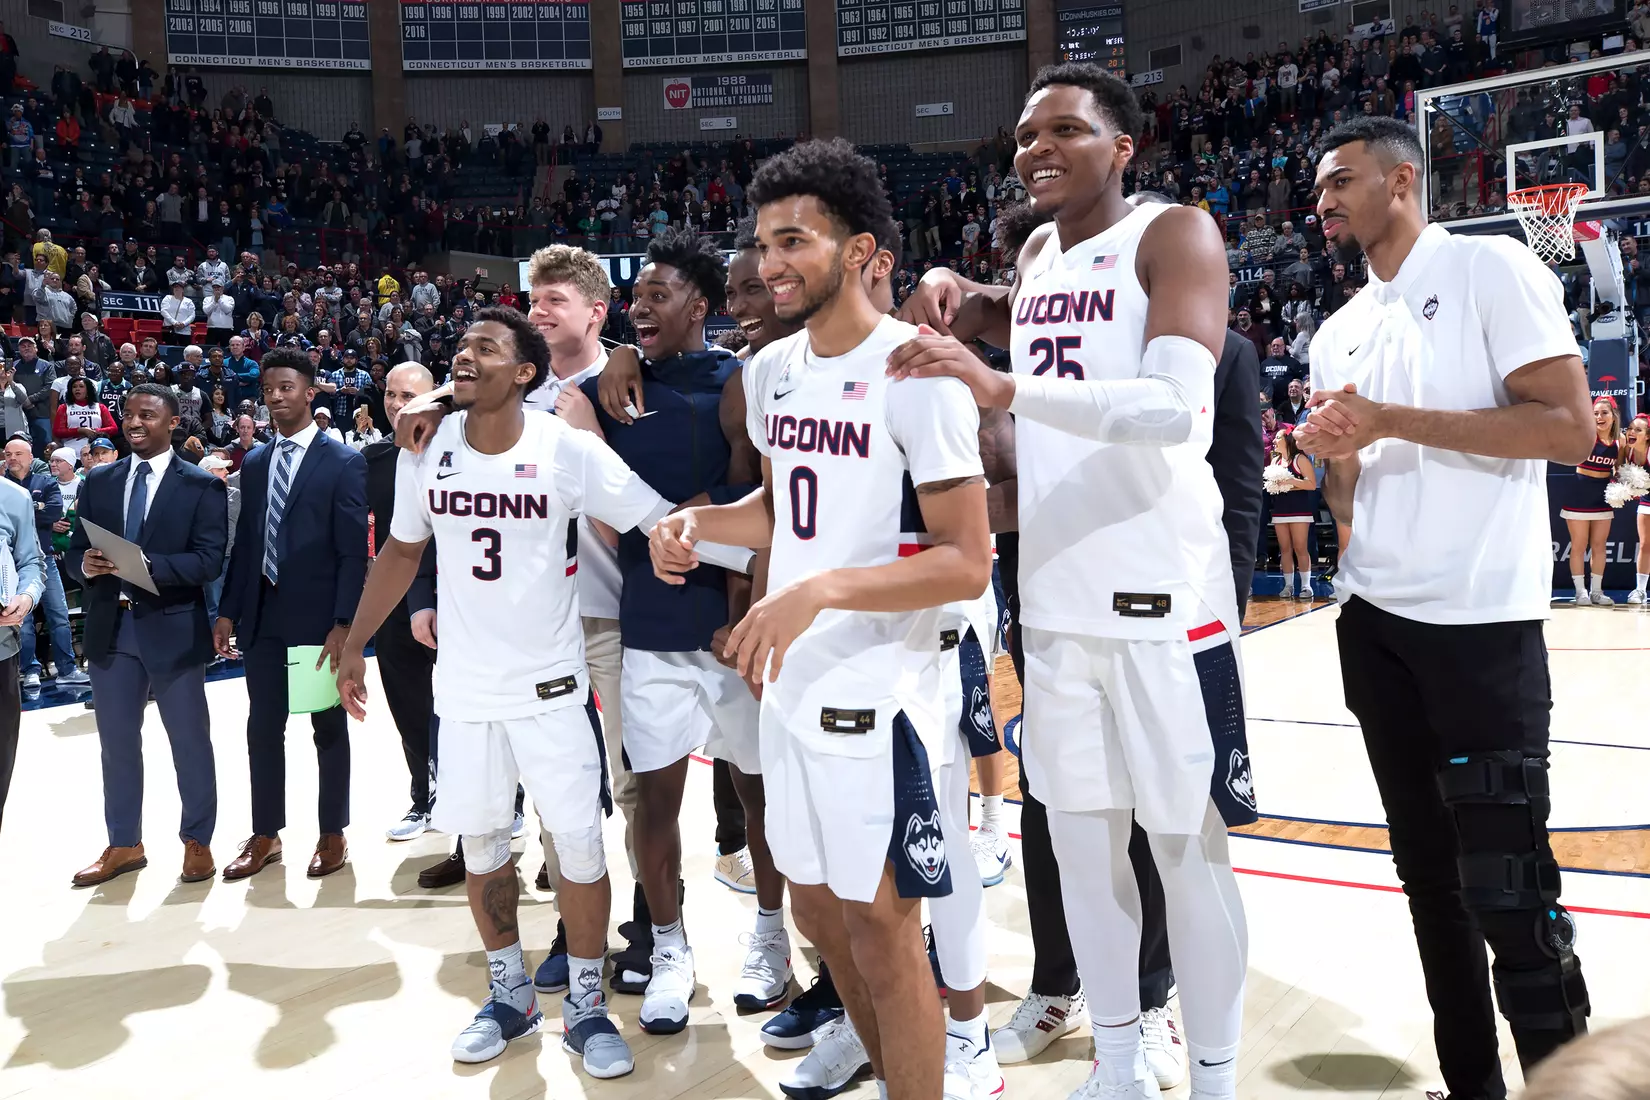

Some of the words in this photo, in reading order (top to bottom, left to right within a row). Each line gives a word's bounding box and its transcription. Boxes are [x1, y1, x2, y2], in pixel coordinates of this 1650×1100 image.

[230, 1, 250, 13] 1995
[258, 2, 279, 14] 1996
[287, 2, 308, 16] 1998
[316, 4, 336, 17] 1999
[344, 5, 365, 18] 2002
[404, 6, 424, 19] 1990
[432, 6, 452, 19] 1996
[459, 6, 478, 19] 1998
[486, 6, 506, 19] 1999
[512, 6, 533, 19] 2002
[539, 6, 560, 19] 2004
[566, 6, 586, 19] 2011
[624, 4, 644, 17] 1955
[651, 3, 670, 16] 1974
[677, 2, 696, 14] 1975
[704, 0, 722, 13] 1980
[730, 0, 748, 12] 1981
[841, 11, 860, 24] 1963
[867, 9, 886, 22] 1964
[894, 6, 913, 19] 1965
[920, 3, 939, 16] 1967
[947, 1, 966, 14] 1976
[975, 0, 994, 11] 1979
[50, 25, 64, 33] SEC
[70, 28, 90, 40] 212
[170, 18, 193, 31] 2003
[200, 19, 223, 32] 2005
[230, 20, 252, 33] 2006
[405, 25, 425, 38] 2016
[626, 24, 645, 36] 1989
[652, 22, 671, 34] 1993
[678, 21, 697, 33] 1997
[704, 20, 723, 32] 2001
[730, 18, 750, 31] 2010
[756, 17, 776, 29] 2015
[842, 30, 860, 43] 1991
[868, 28, 887, 41] 1992
[894, 25, 914, 38] 1994
[921, 23, 940, 36] 1995
[948, 20, 967, 33] 1996
[975, 17, 994, 31] 1998
[1002, 15, 1022, 28] 1999
[844, 42, 914, 55] CONNECTICUT
[919, 38, 950, 48] MEN'S
[954, 32, 1021, 45] BASKETBALL
[175, 56, 252, 65] CONNECTICUT
[258, 58, 291, 66] MEN'S
[296, 59, 365, 68] BASKETBALL
[521, 60, 587, 68] BASKETBALL
[628, 56, 698, 66] CONNECTICUT
[703, 54, 733, 63] MEN'S
[738, 51, 802, 60] BASKETBALL
[717, 76, 747, 85] 1988
[1144, 70, 1162, 83] 213
[669, 89, 687, 98] NIT
[692, 87, 726, 97] NATIONAL
[731, 84, 772, 94] INVITATION
[692, 96, 736, 107] TOURNAMENT
[739, 94, 773, 104] CHAMPION
[942, 104, 948, 113] 6
[726, 119, 732, 127] 5
[1238, 267, 1264, 282] 114
[103, 297, 123, 306] SEC
[135, 297, 160, 310] 111
[1016, 289, 1115, 325] UCONN
[1029, 336, 1085, 380] 25
[79, 416, 93, 428] 21
[765, 414, 871, 458] UCONN
[1587, 455, 1616, 465] UCON
[428, 489, 548, 519] UCONN
[790, 466, 818, 540] 0
[471, 527, 501, 581] 3
[860, 715, 870, 724] 44
